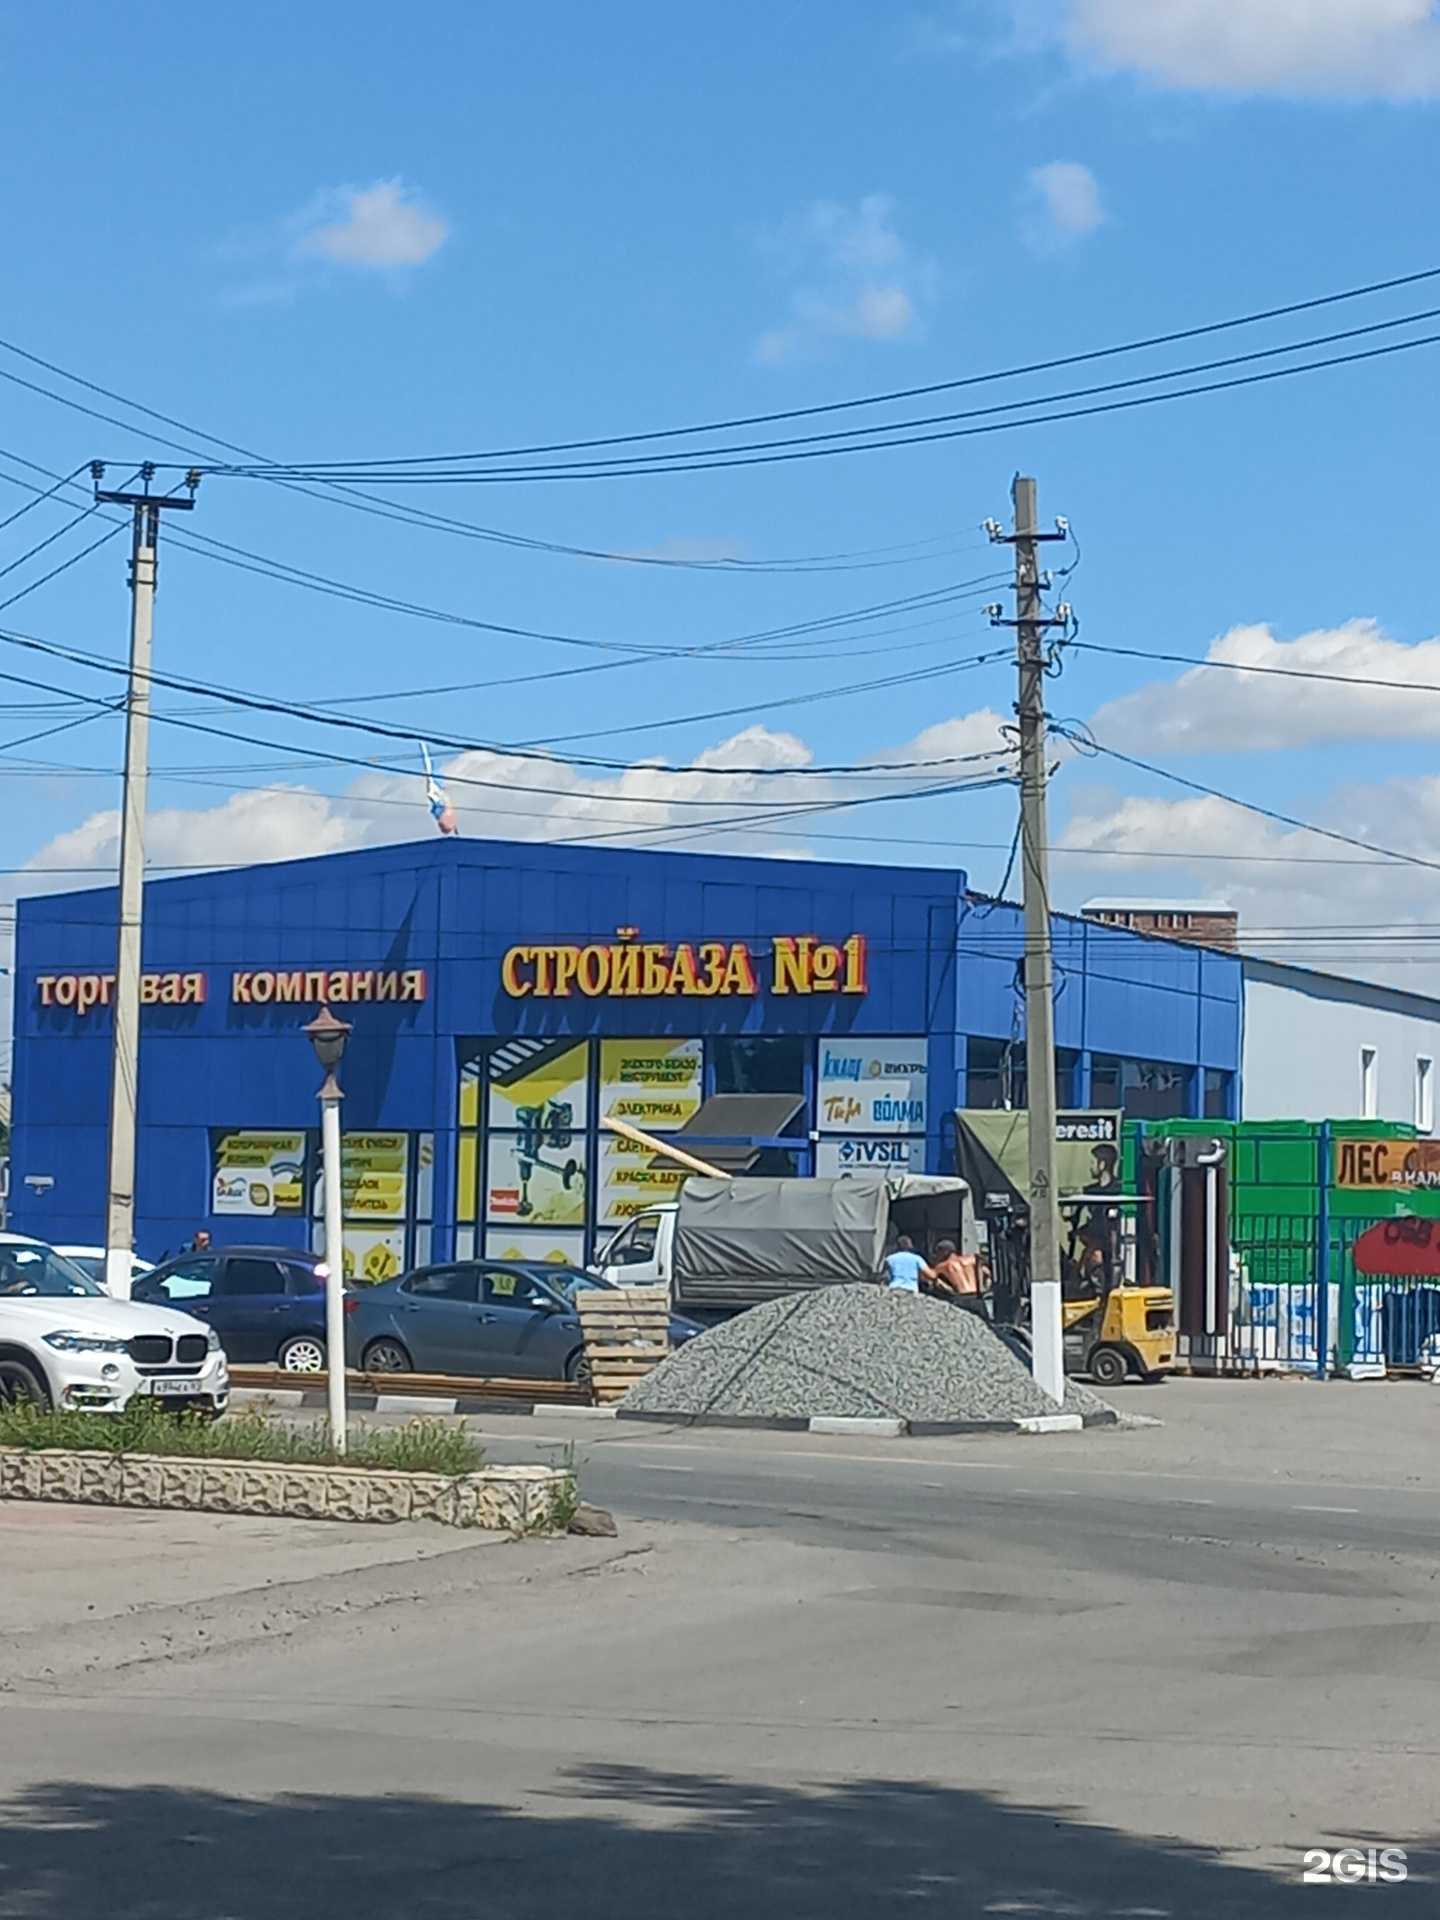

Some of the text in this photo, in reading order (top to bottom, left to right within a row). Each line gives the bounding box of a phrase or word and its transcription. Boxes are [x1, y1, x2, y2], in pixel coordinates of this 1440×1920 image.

[502, 926, 757, 998] СТРОЙБАЗА
[36, 969, 426, 1015] торгвая компания
[1056, 1118, 1114, 1139] eresit
[1338, 1143, 1389, 1184] ЛЕС
